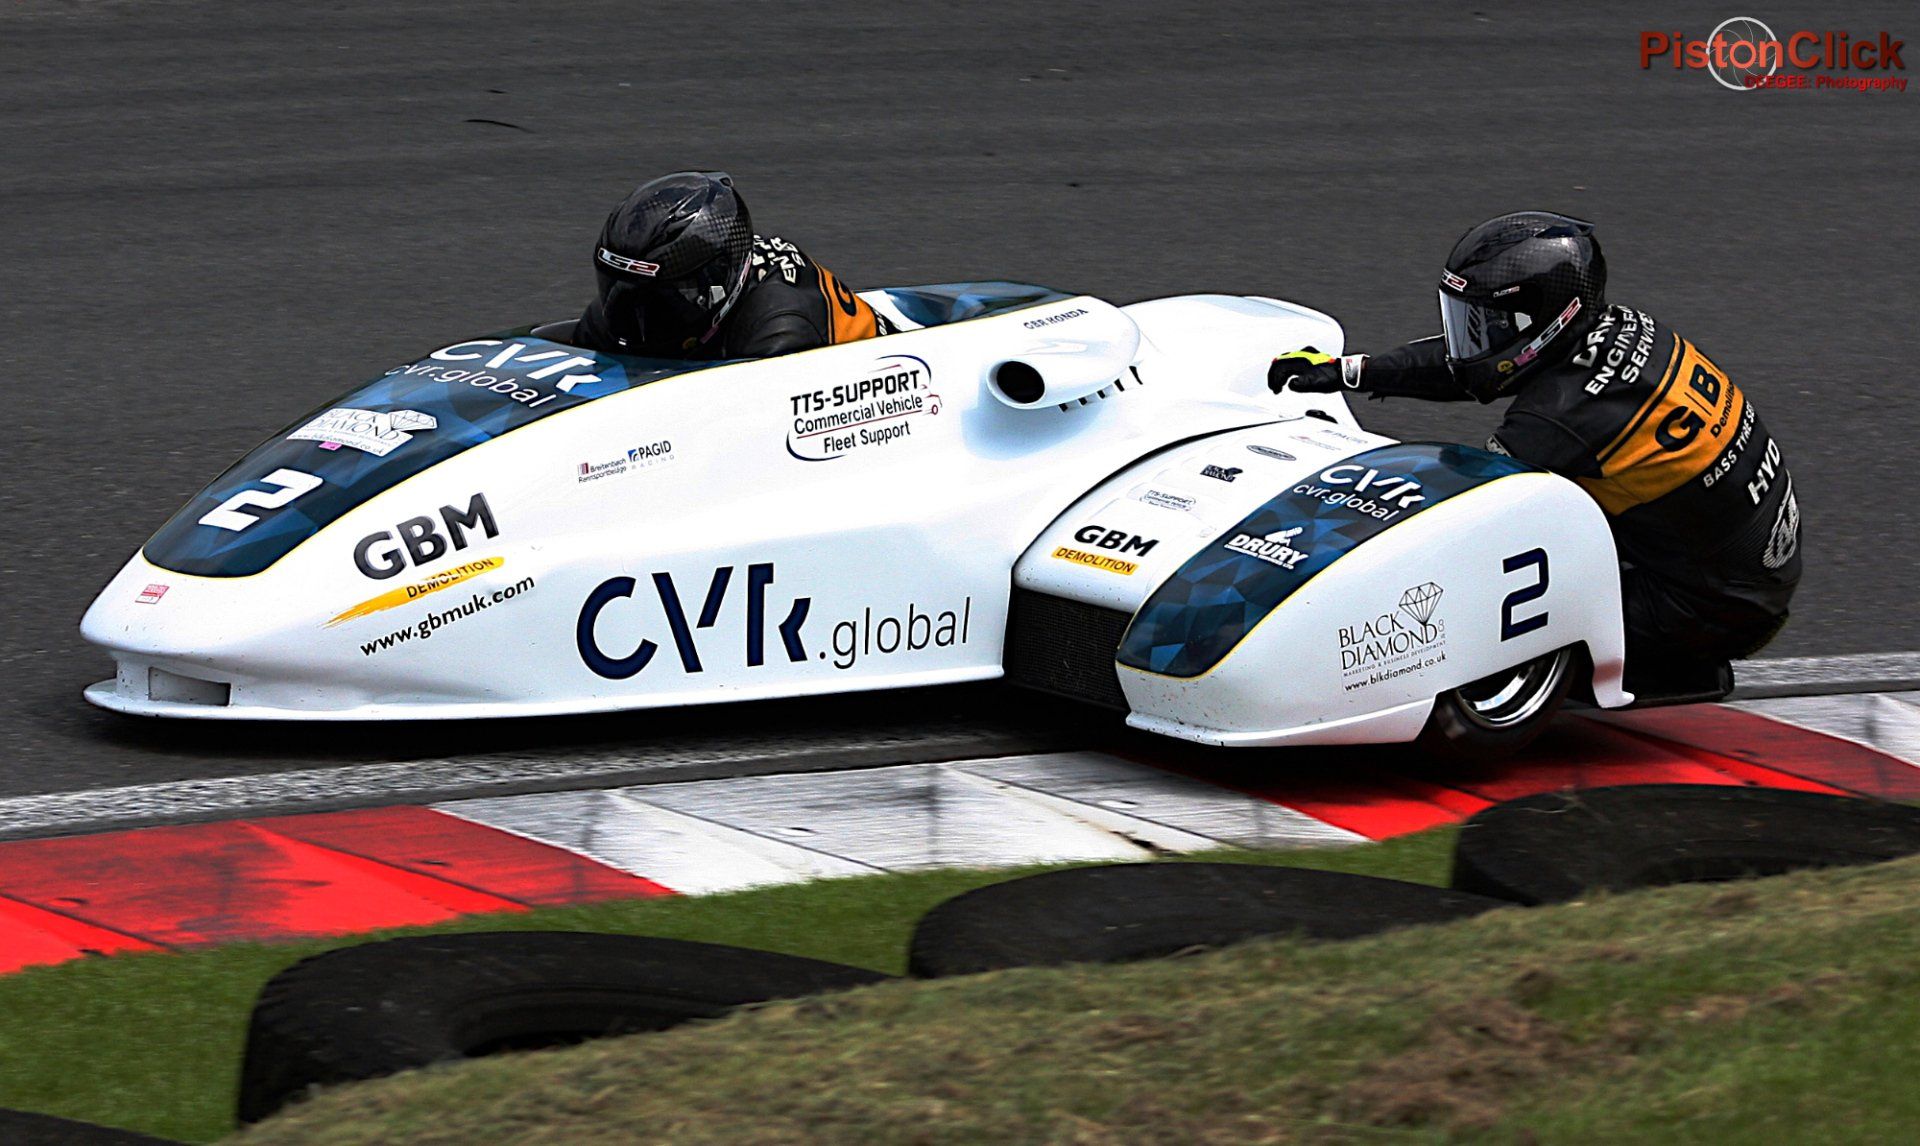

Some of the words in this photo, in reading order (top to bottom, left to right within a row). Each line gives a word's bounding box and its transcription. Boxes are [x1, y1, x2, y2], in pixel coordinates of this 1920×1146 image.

[1047, 308, 1089, 324] HONDA
[384, 364, 557, 408] cvr.global
[789, 369, 921, 416] TTS-SUPPORT
[793, 400, 876, 435] Commercial
[875, 394, 924, 422] Vehicle
[637, 440, 672, 460] PAGID
[823, 430, 857, 454] Fleet
[859, 420, 911, 448] Support
[1703, 449, 1738, 488] BASS
[198, 468, 324, 532] 2
[1292, 483, 1402, 523] cvr.global
[352, 491, 500, 581] GBM
[1073, 523, 1161, 559] GBM
[1228, 533, 1310, 566] DRURY
[405, 557, 495, 599] DEMOLITION
[1055, 547, 1136, 574] DEMOLITION
[1500, 546, 1551, 643] 2
[359, 574, 536, 657] www.gbmuk.com
[1338, 608, 1405, 648] BLACK
[1341, 623, 1438, 671] DIAMOND
[1344, 650, 1447, 692] www.blkdiamond.co.uk
